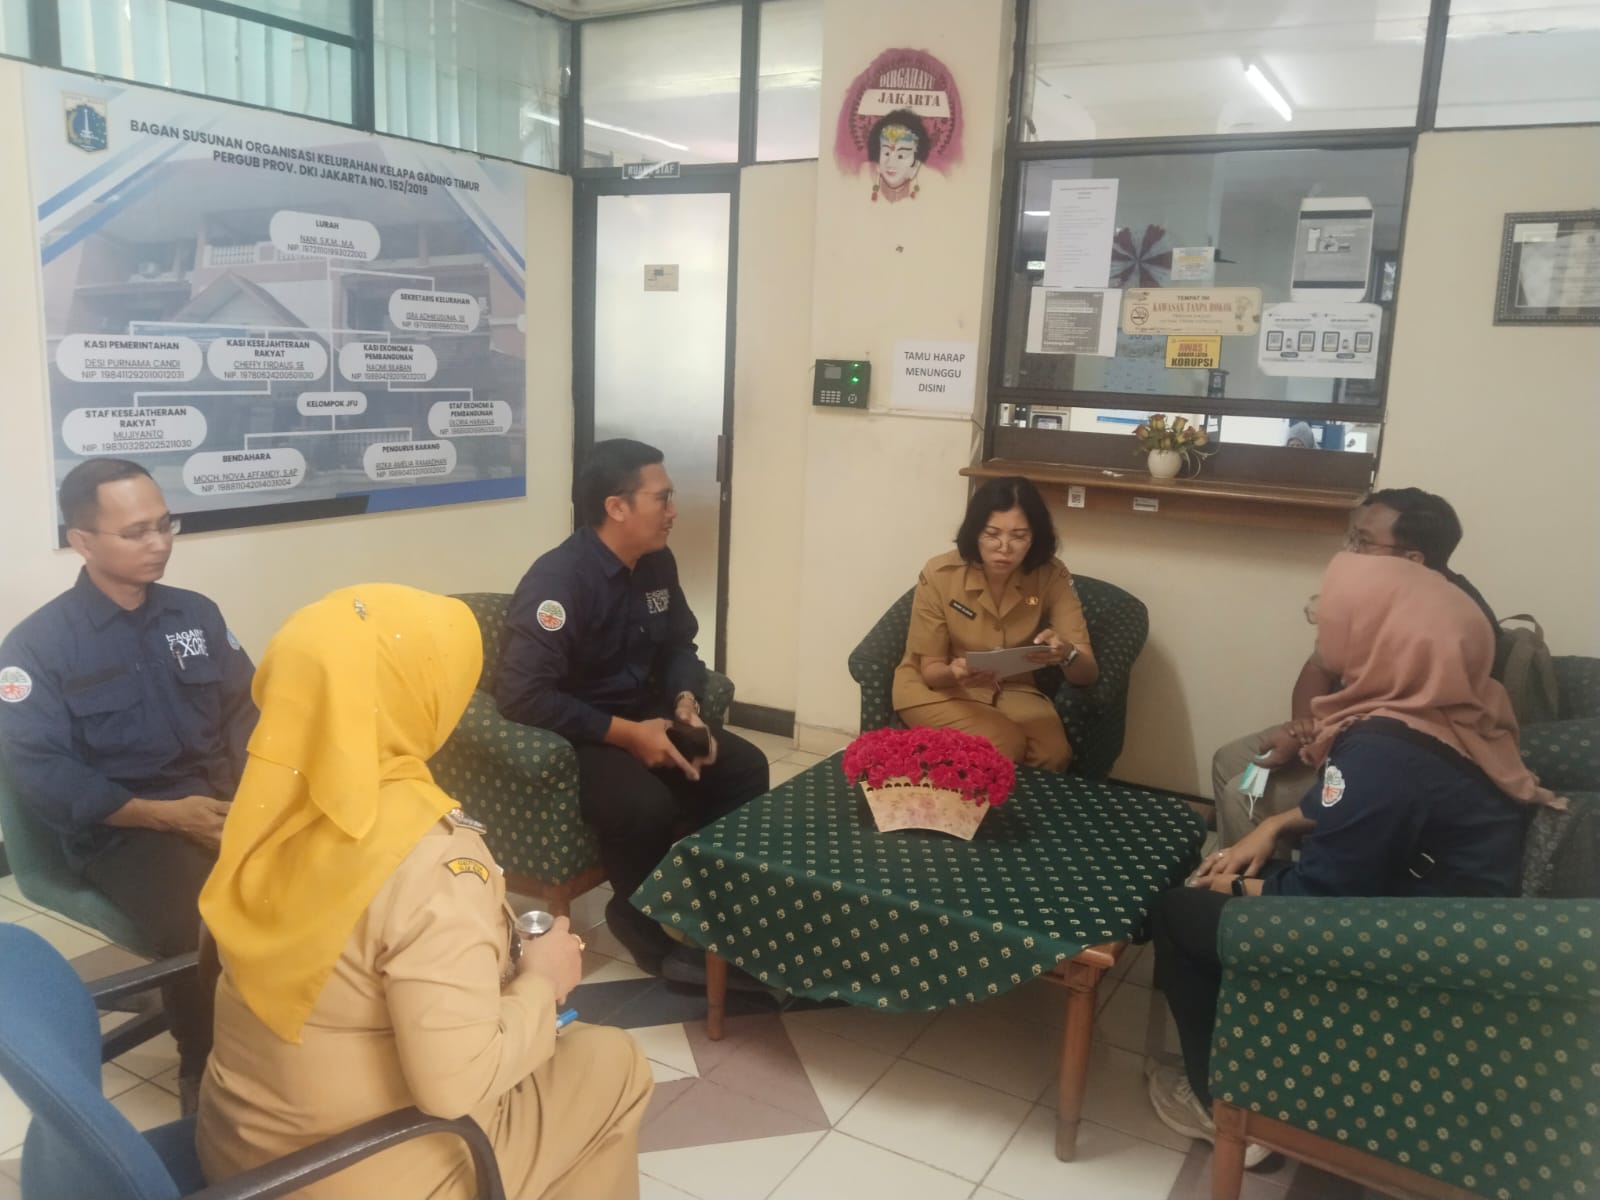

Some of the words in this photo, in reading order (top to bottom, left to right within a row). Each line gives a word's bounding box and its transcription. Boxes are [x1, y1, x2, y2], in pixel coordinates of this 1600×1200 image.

[879, 67, 936, 89] DIRGAHAYU
[878, 92, 941, 107] JAKARTA
[130, 119, 180, 139] BAGAN
[182, 129, 243, 150] SUSUNAN
[245, 140, 316, 163] ORGANISASI
[317, 154, 378, 174] KELURAHAN
[380, 164, 416, 180] KELAPA
[417, 172, 453, 187] GADING
[454, 178, 480, 192] TIMUR
[213, 150, 260, 168] PERGUB
[262, 158, 297, 174] PROV.
[299, 165, 318, 177] DKI
[320, 167, 368, 185] JAKARTA
[369, 178, 387, 189] NO.
[388, 179, 428, 196] 152/2019
[315, 219, 339, 230] LURAH
[400, 293, 434, 302] SEKRETARIS
[435, 296, 470, 305] KELURAHAN
[1152, 302, 1185, 313] KAWASAN
[1186, 301, 1208, 313] TANPA
[1209, 302, 1232, 313] ROKOK
[84, 340, 107, 349] KASI
[109, 340, 179, 350] PEMERINTAHAN
[227, 339, 246, 347] KASI
[247, 340, 310, 349] KESEJAHTERAAN
[363, 343, 379, 352] KASI
[380, 344, 408, 353] EKONOMI
[1178, 343, 1203, 352] AWAS
[254, 349, 286, 358] RAKYAT
[364, 352, 414, 361] PEMBANGUNAN
[904, 351, 931, 361] TAMU
[933, 352, 966, 362] HARAP
[84, 358, 105, 368] DESI
[107, 358, 151, 368] PURNAMA
[152, 359, 181, 368] CANDI
[1171, 357, 1214, 368] KORUPSI
[905, 367, 962, 378] MENUNGGU
[918, 383, 946, 393] DISINI
[306, 400, 344, 408] KELOMPOK
[345, 400, 359, 408] JFU
[84, 410, 109, 418] STAF
[111, 408, 187, 418] KESEJATHERAAN
[119, 419, 157, 428] RAKYAT
[113, 430, 164, 440] MUJIYANTO
[382, 444, 414, 453] PENGURUS
[415, 443, 441, 452] BARANG
[222, 453, 271, 463] BENDAHARA
[221, 472, 246, 481] NOVA
